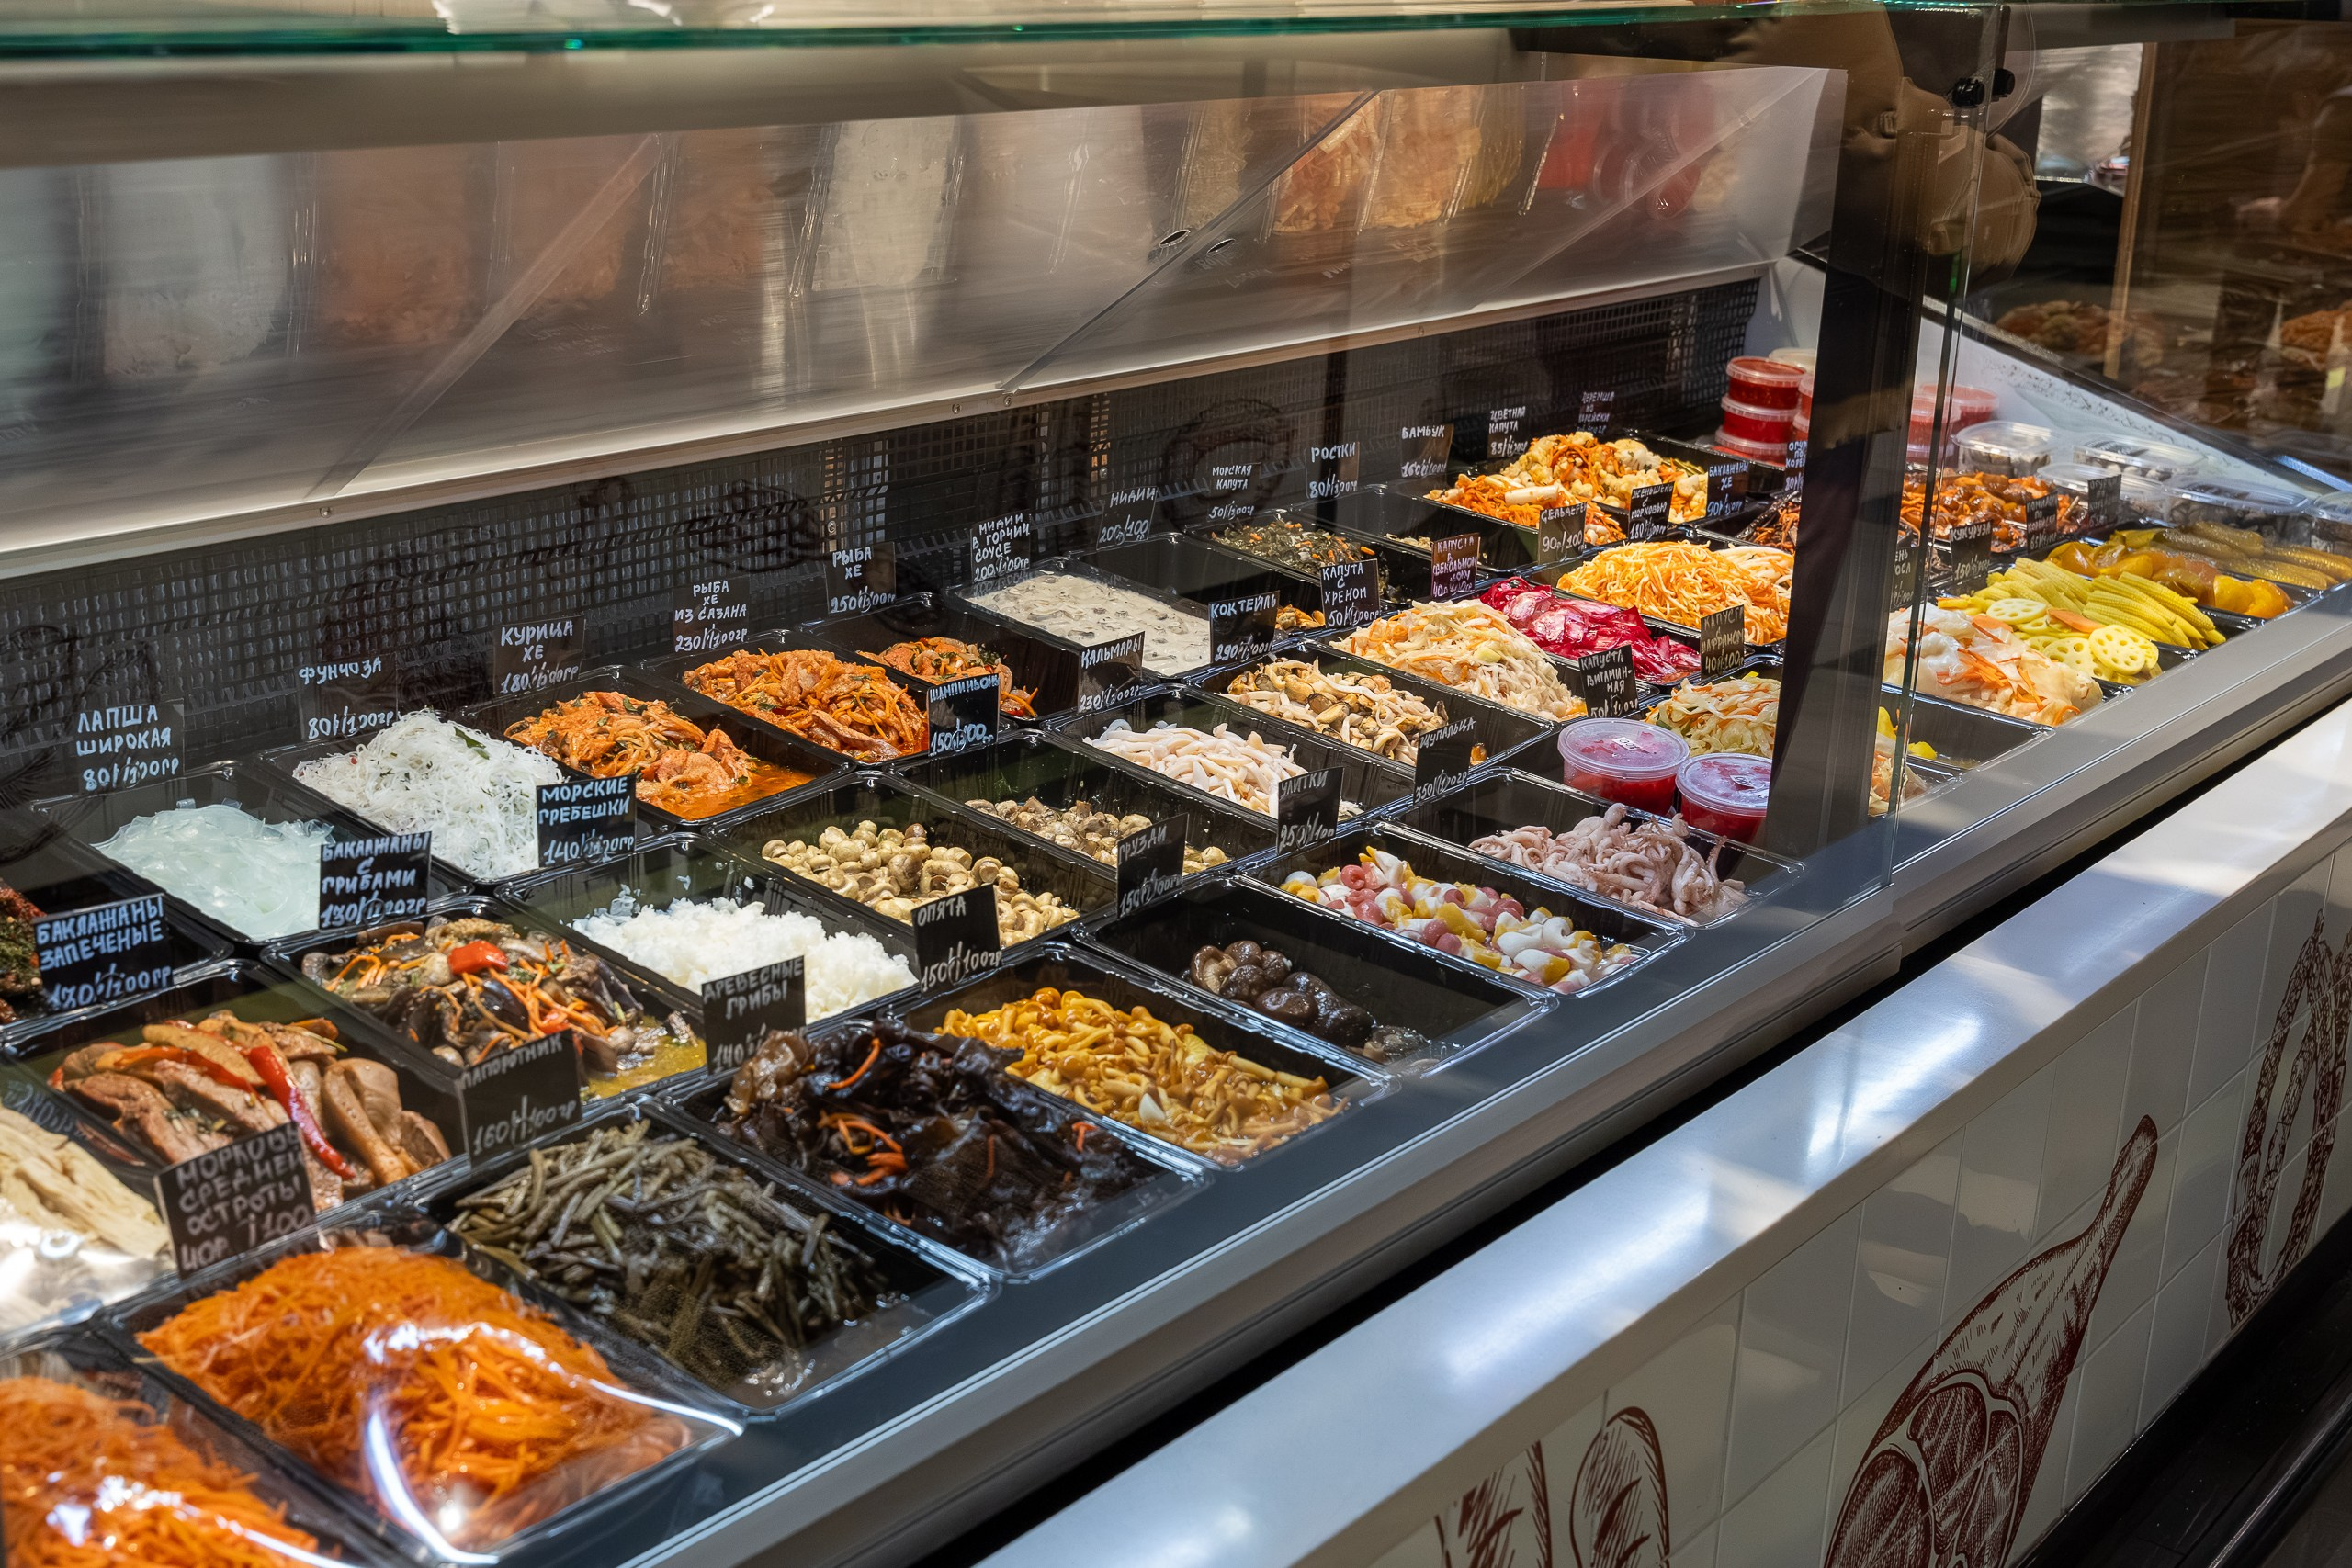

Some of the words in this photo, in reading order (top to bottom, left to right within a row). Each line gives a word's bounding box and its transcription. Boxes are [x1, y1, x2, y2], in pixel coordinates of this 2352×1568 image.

[1401, 424, 1445, 440] БАМБУК
[1311, 442, 1356, 463] РОСТКИ
[1212, 464, 1252, 476] МОРСКАЯ
[1216, 479, 1249, 491] КАПУТА
[978, 513, 1023, 535] МИДИИ
[832, 546, 872, 568] РЫБА
[975, 542, 1012, 563] СОУСЕ
[844, 564, 862, 580] ХЕ
[1322, 562, 1363, 581] КАПУТА
[693, 580, 729, 598] РЫБА
[702, 594, 718, 606] ХЕ
[1324, 586, 1367, 606] ХРЕНОМ
[674, 608, 694, 624] ИЗ
[697, 604, 747, 621] САЗАНА
[501, 620, 573, 647] КУРИЦА
[522, 644, 544, 663] ХЕ
[1081, 635, 1142, 669] КАЛЬМАРЫ
[1580, 649, 1623, 671] КАПУСТА
[299, 656, 381, 684] ФУНЧОЗА
[1606, 680, 1625, 694] НАЯ
[77, 705, 158, 733] ЛАПША
[76, 727, 171, 756] ШИРОКАЯ
[1419, 716, 1476, 749] ЩУПАЛЬЦА
[542, 776, 628, 804] МОРСКИЕ
[1279, 770, 1329, 801] УЛИТКИ
[538, 795, 630, 826] ГРЕБЕШКИ
[356, 856, 375, 875] С
[322, 868, 416, 896] ГРИБАМИ
[36, 896, 164, 944] БАКЛАЖАНЫ
[917, 895, 967, 927] ОПЯТА
[40, 919, 164, 971] ЗАПЕЧЕНЫЕ
[704, 957, 804, 1005] ДРЕВЕСНЫЕ
[726, 979, 788, 1020] ГРИБЫ
[461, 1032, 563, 1090] ПАПОРОТНИК
[186, 1175, 301, 1235] ОСТРОТЫ
